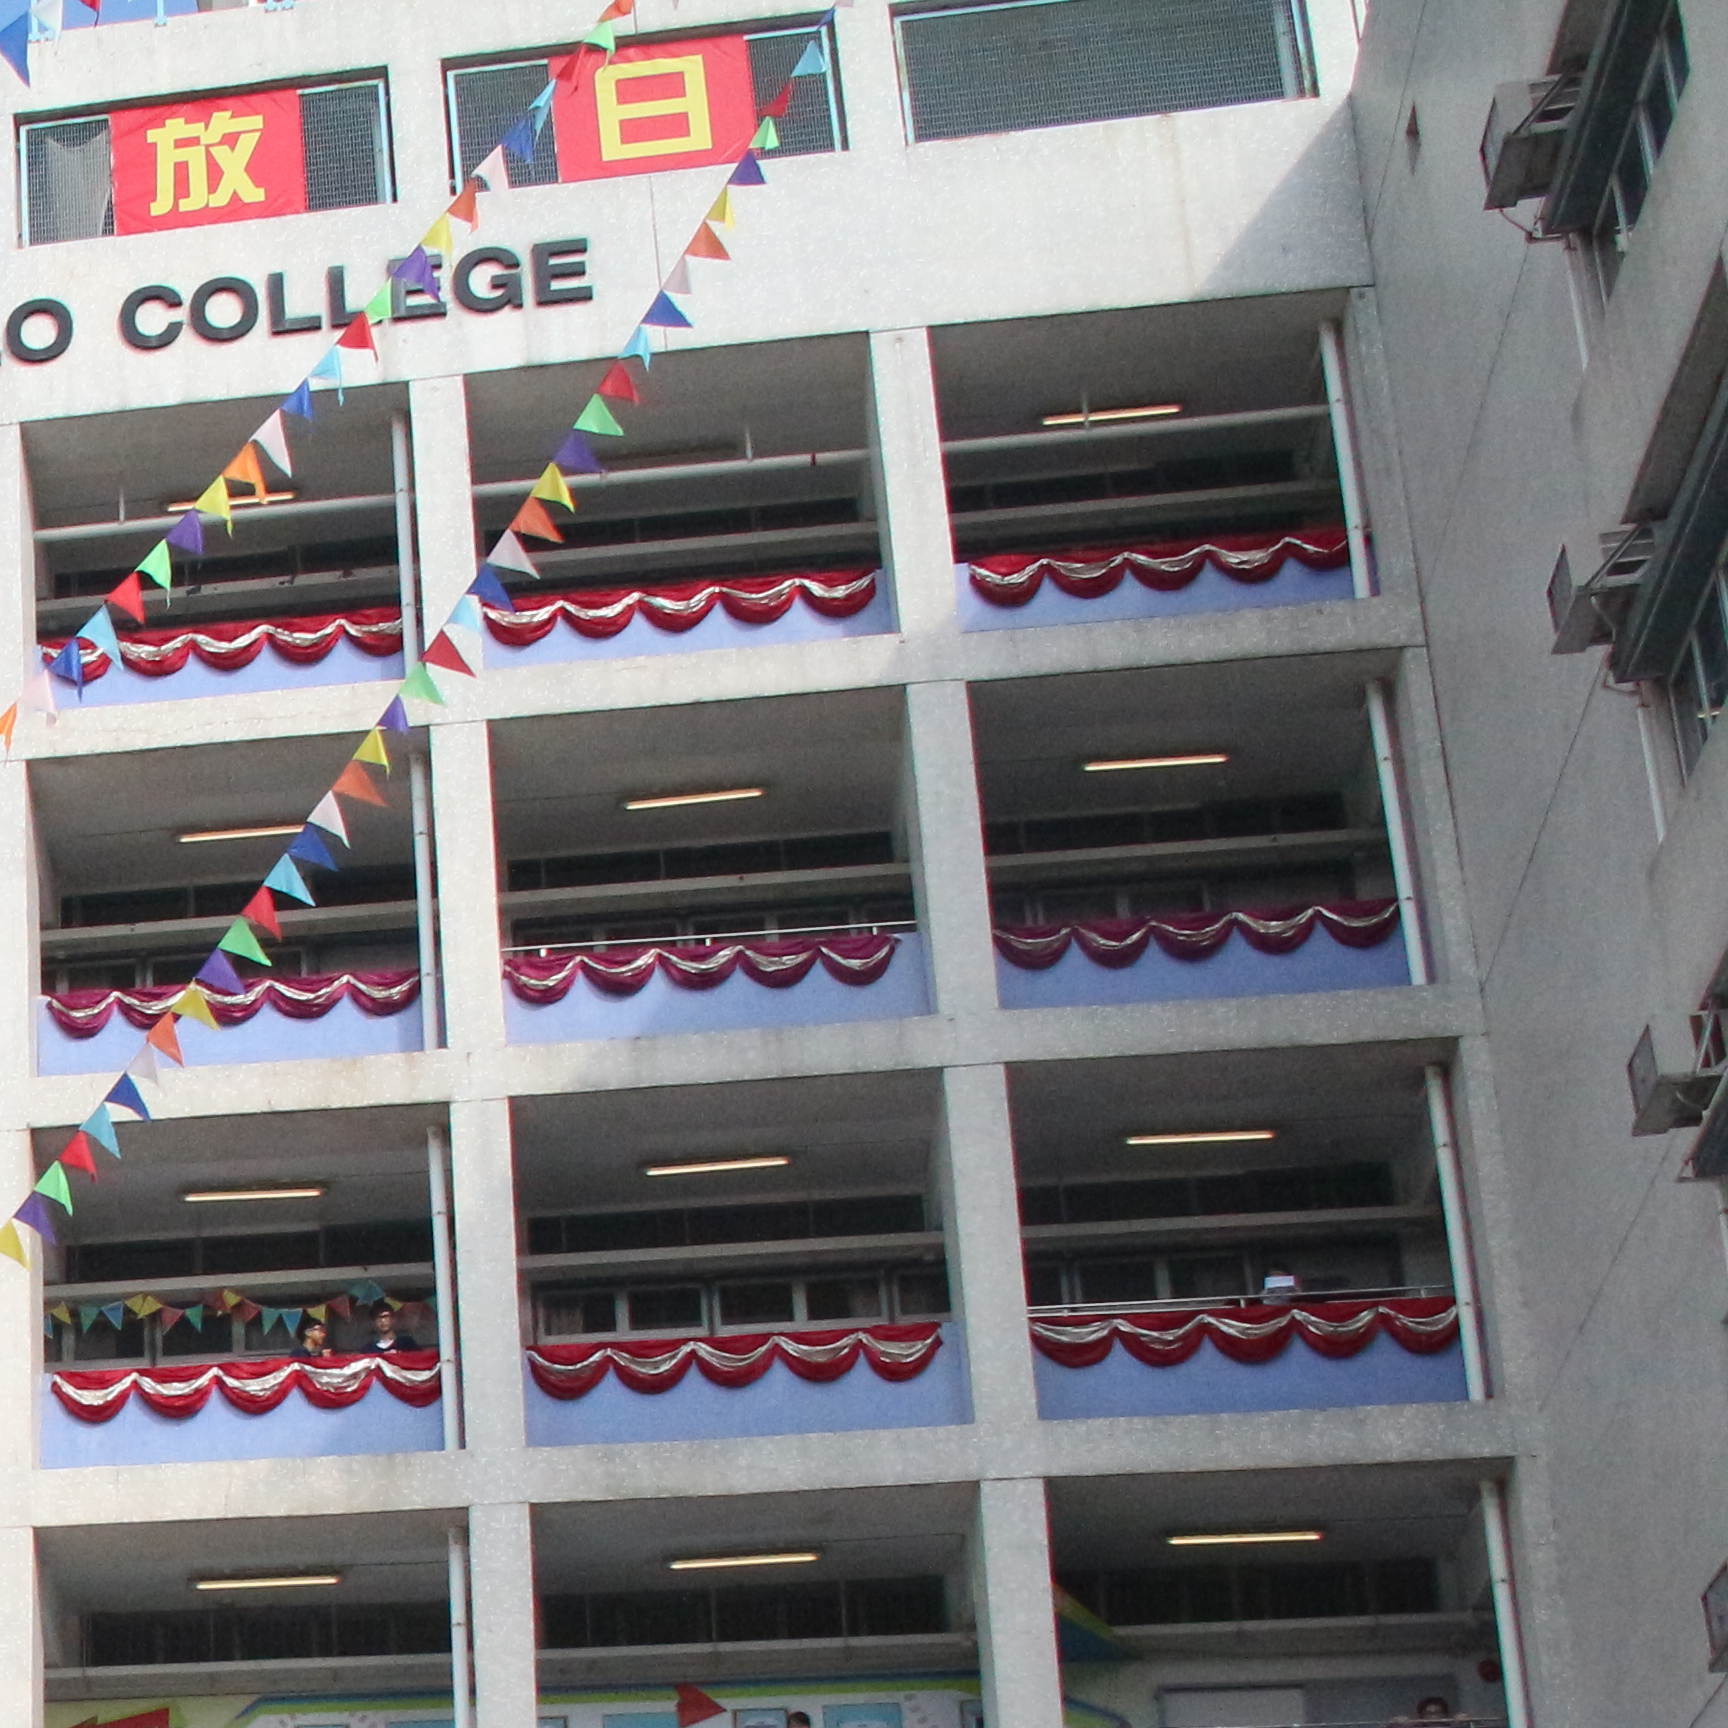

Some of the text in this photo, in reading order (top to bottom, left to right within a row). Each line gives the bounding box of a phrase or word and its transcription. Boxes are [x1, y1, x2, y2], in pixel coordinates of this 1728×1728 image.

[145, 110, 265, 216] 放
[595, 54, 714, 163] 日
[120, 238, 594, 353] COLLEGE
